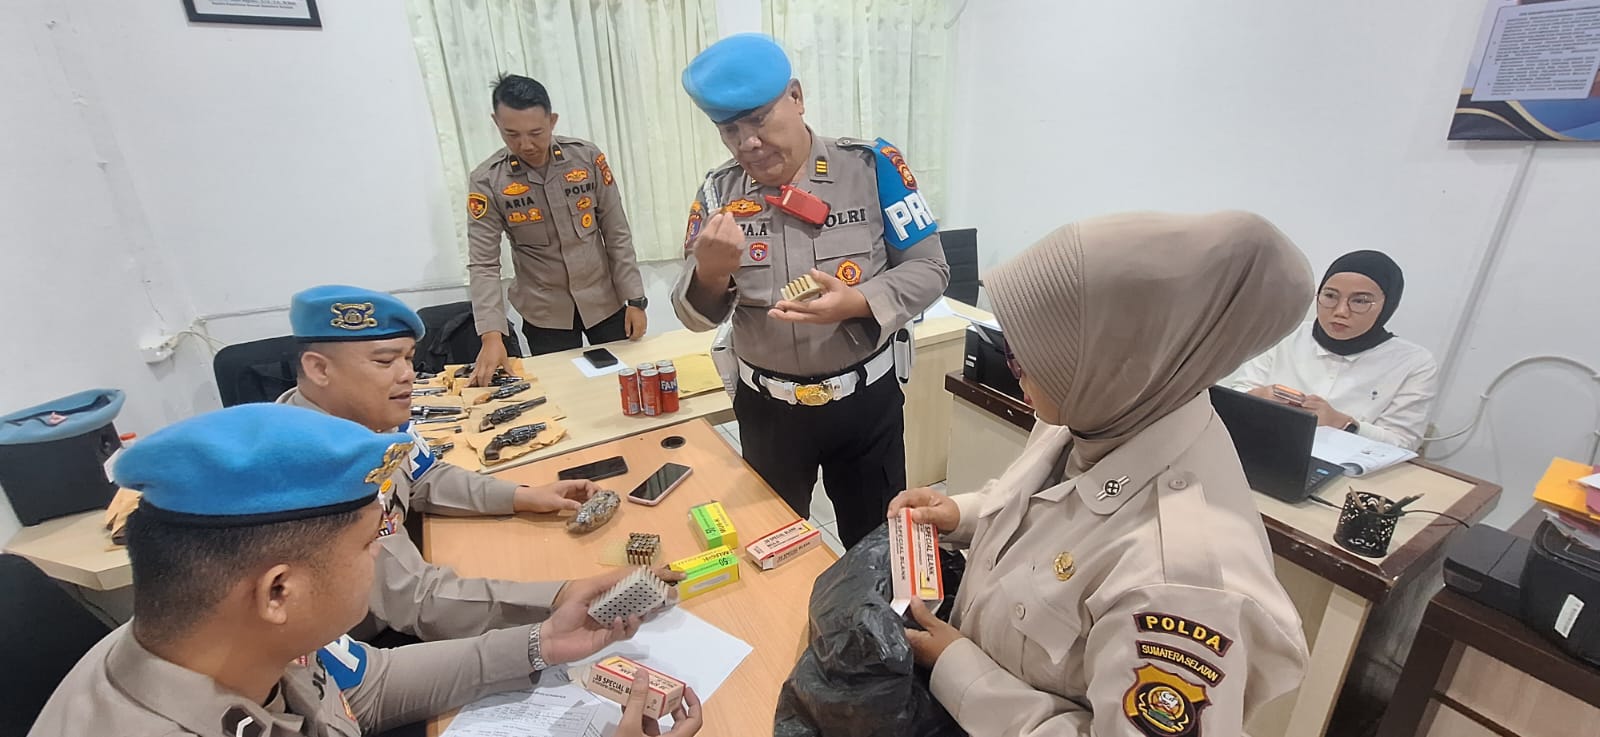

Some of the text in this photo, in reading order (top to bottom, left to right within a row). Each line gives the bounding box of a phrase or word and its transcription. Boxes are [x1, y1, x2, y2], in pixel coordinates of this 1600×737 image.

[565, 182, 595, 197] POLRI
[505, 196, 535, 210] ARIA
[824, 208, 866, 229] OLRI
[924, 526, 933, 552] SPECIAL
[1145, 615, 1221, 651] POLDA
[1141, 645, 1219, 682] SUMATERA SELATAN
[602, 676, 625, 691] SPECIAL
